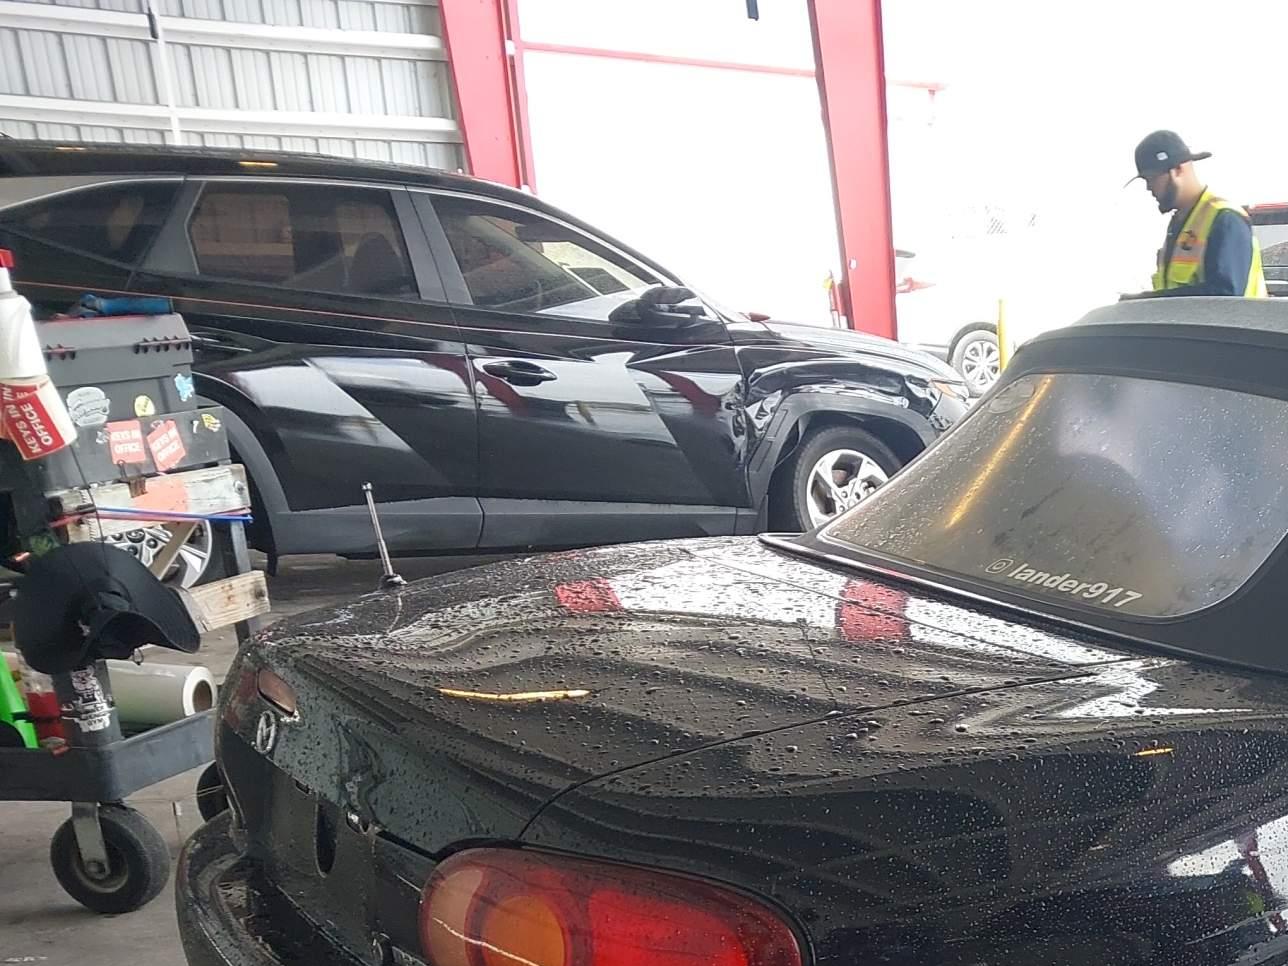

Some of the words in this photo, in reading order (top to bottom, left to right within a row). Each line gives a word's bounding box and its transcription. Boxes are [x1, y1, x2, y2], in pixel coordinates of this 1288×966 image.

[5, 404, 21, 419] IN
[19, 402, 53, 446] OFFICE
[16, 420, 43, 453] KEYS
[1006, 562, 1143, 608] lander917
